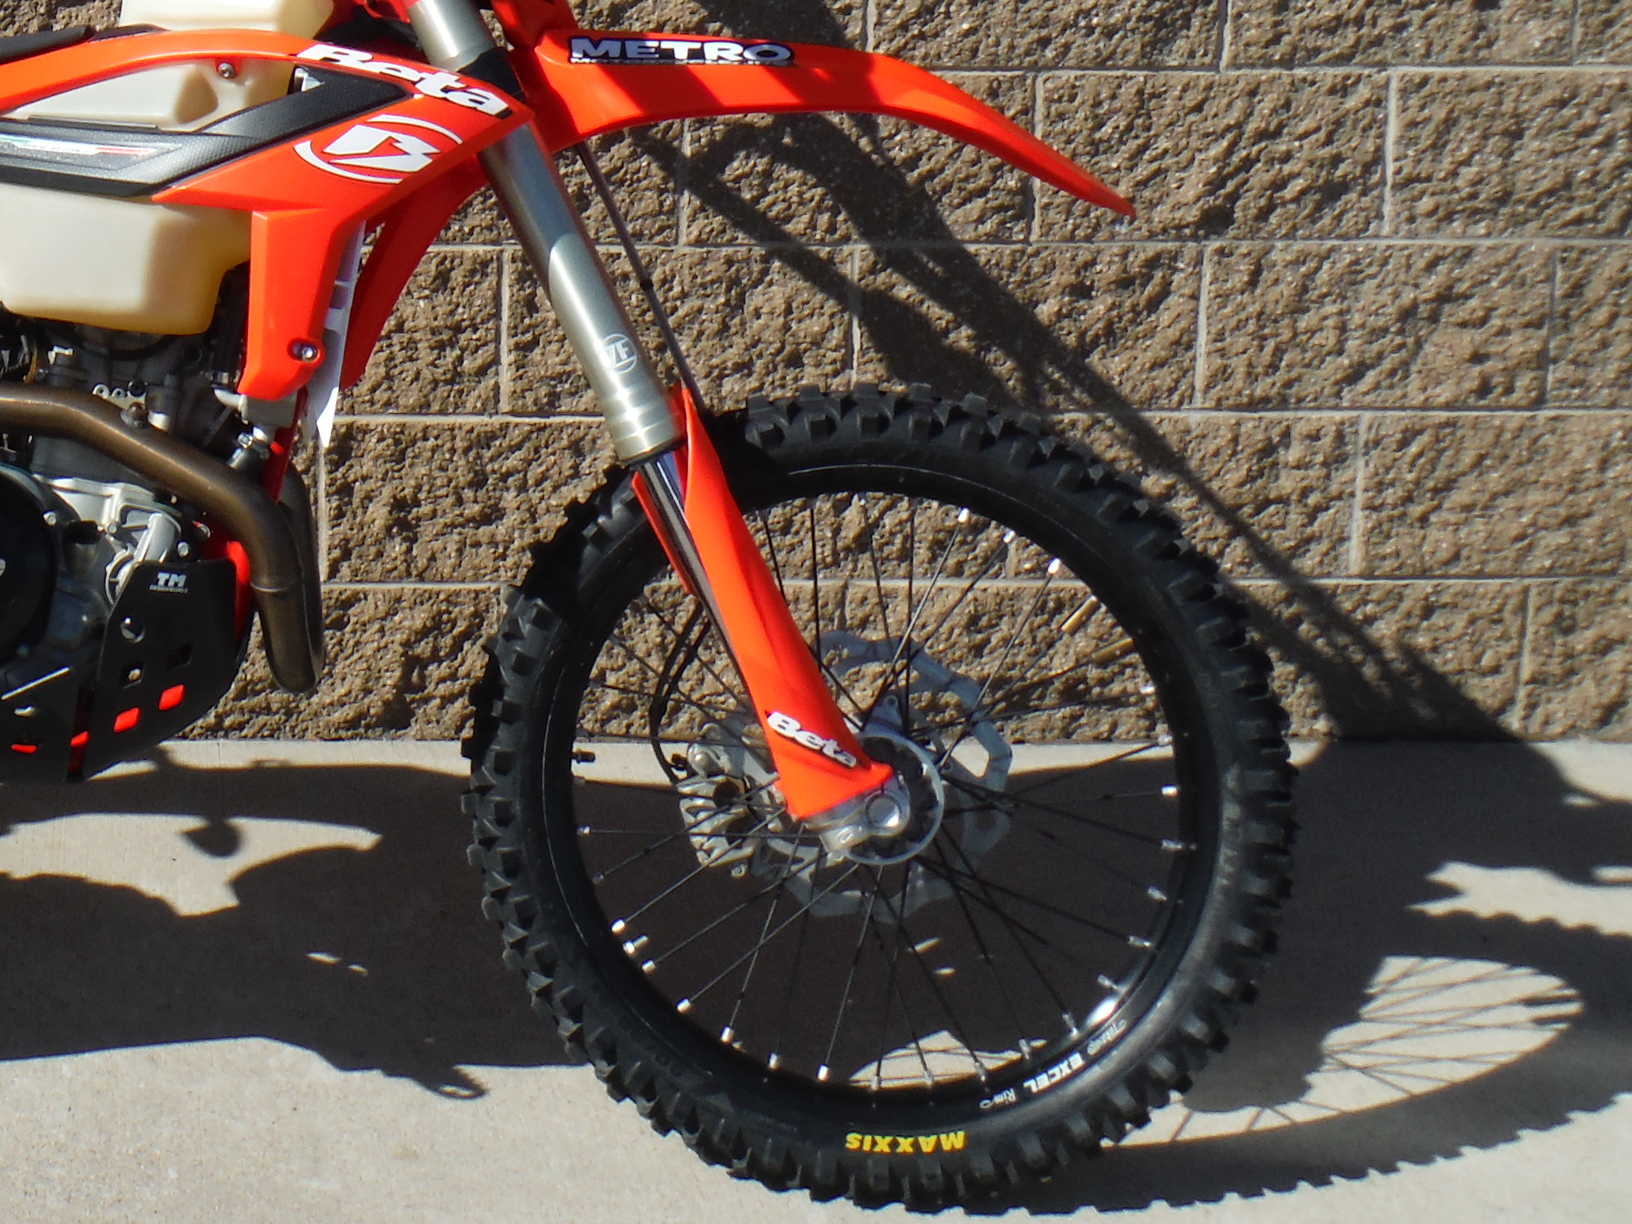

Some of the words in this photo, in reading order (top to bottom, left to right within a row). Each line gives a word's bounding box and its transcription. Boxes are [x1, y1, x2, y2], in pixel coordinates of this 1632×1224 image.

[570, 37, 792, 62] METRO
[296, 43, 511, 117] Beta
[157, 571, 187, 588] TM
[766, 710, 858, 769] Beta
[1022, 1051, 1086, 1094] EXCEL
[844, 1130, 967, 1154] MAXXIS
